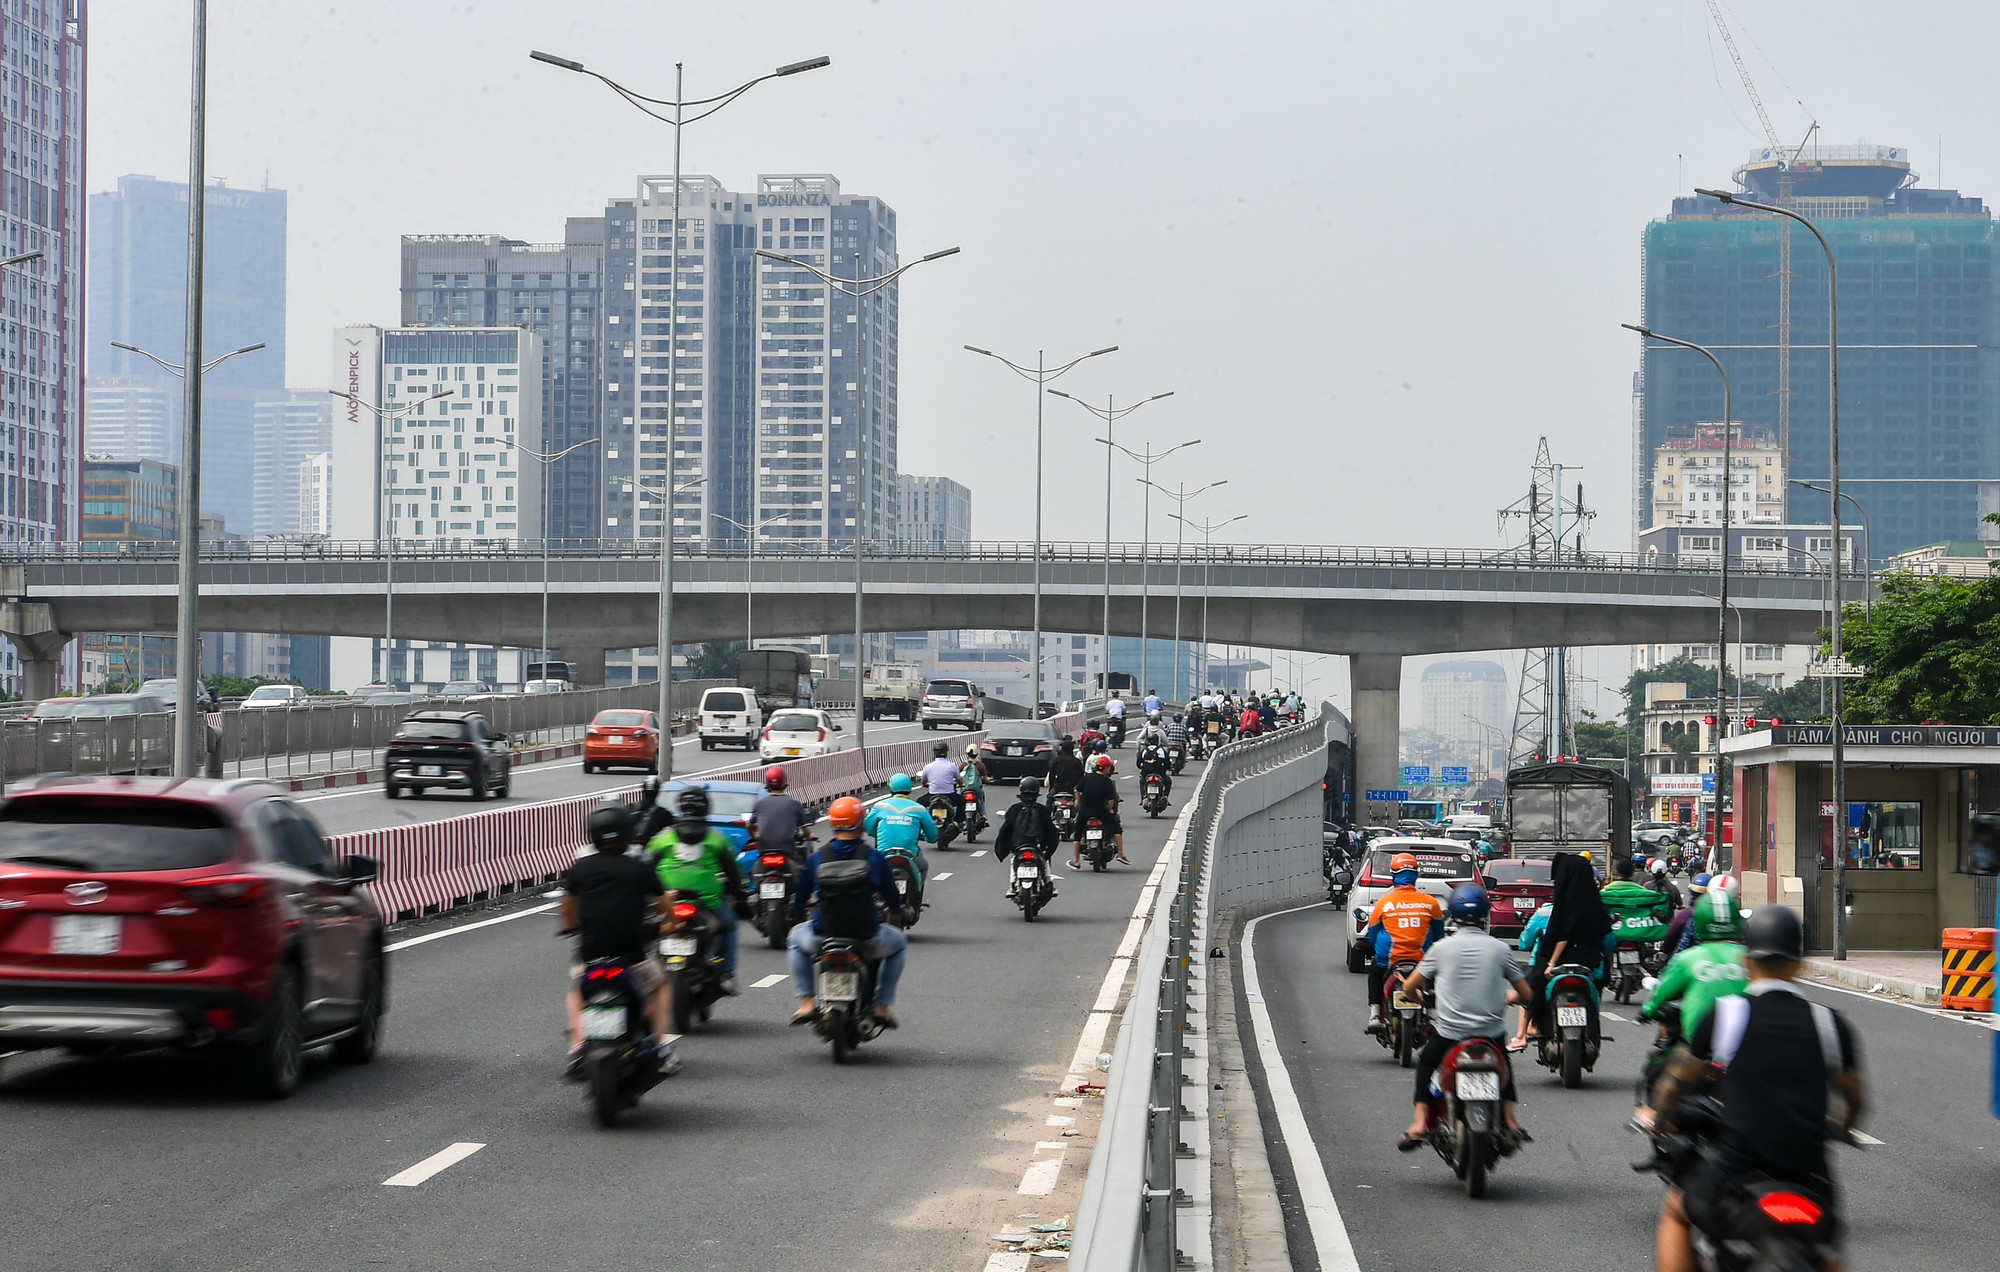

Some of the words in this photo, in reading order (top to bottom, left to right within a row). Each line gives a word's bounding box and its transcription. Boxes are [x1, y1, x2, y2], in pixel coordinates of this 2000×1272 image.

[174, 190, 233, 207] LAMARK
[235, 193, 250, 209] 72
[757, 193, 831, 207] BONANZA
[347, 350, 360, 424] MÖVENPICK
[1787, 727, 1823, 743] HẦM
[1842, 727, 1880, 744] ÀNH
[1891, 730, 1923, 744] CHO
[1935, 728, 1985, 745] NGƯỜI
